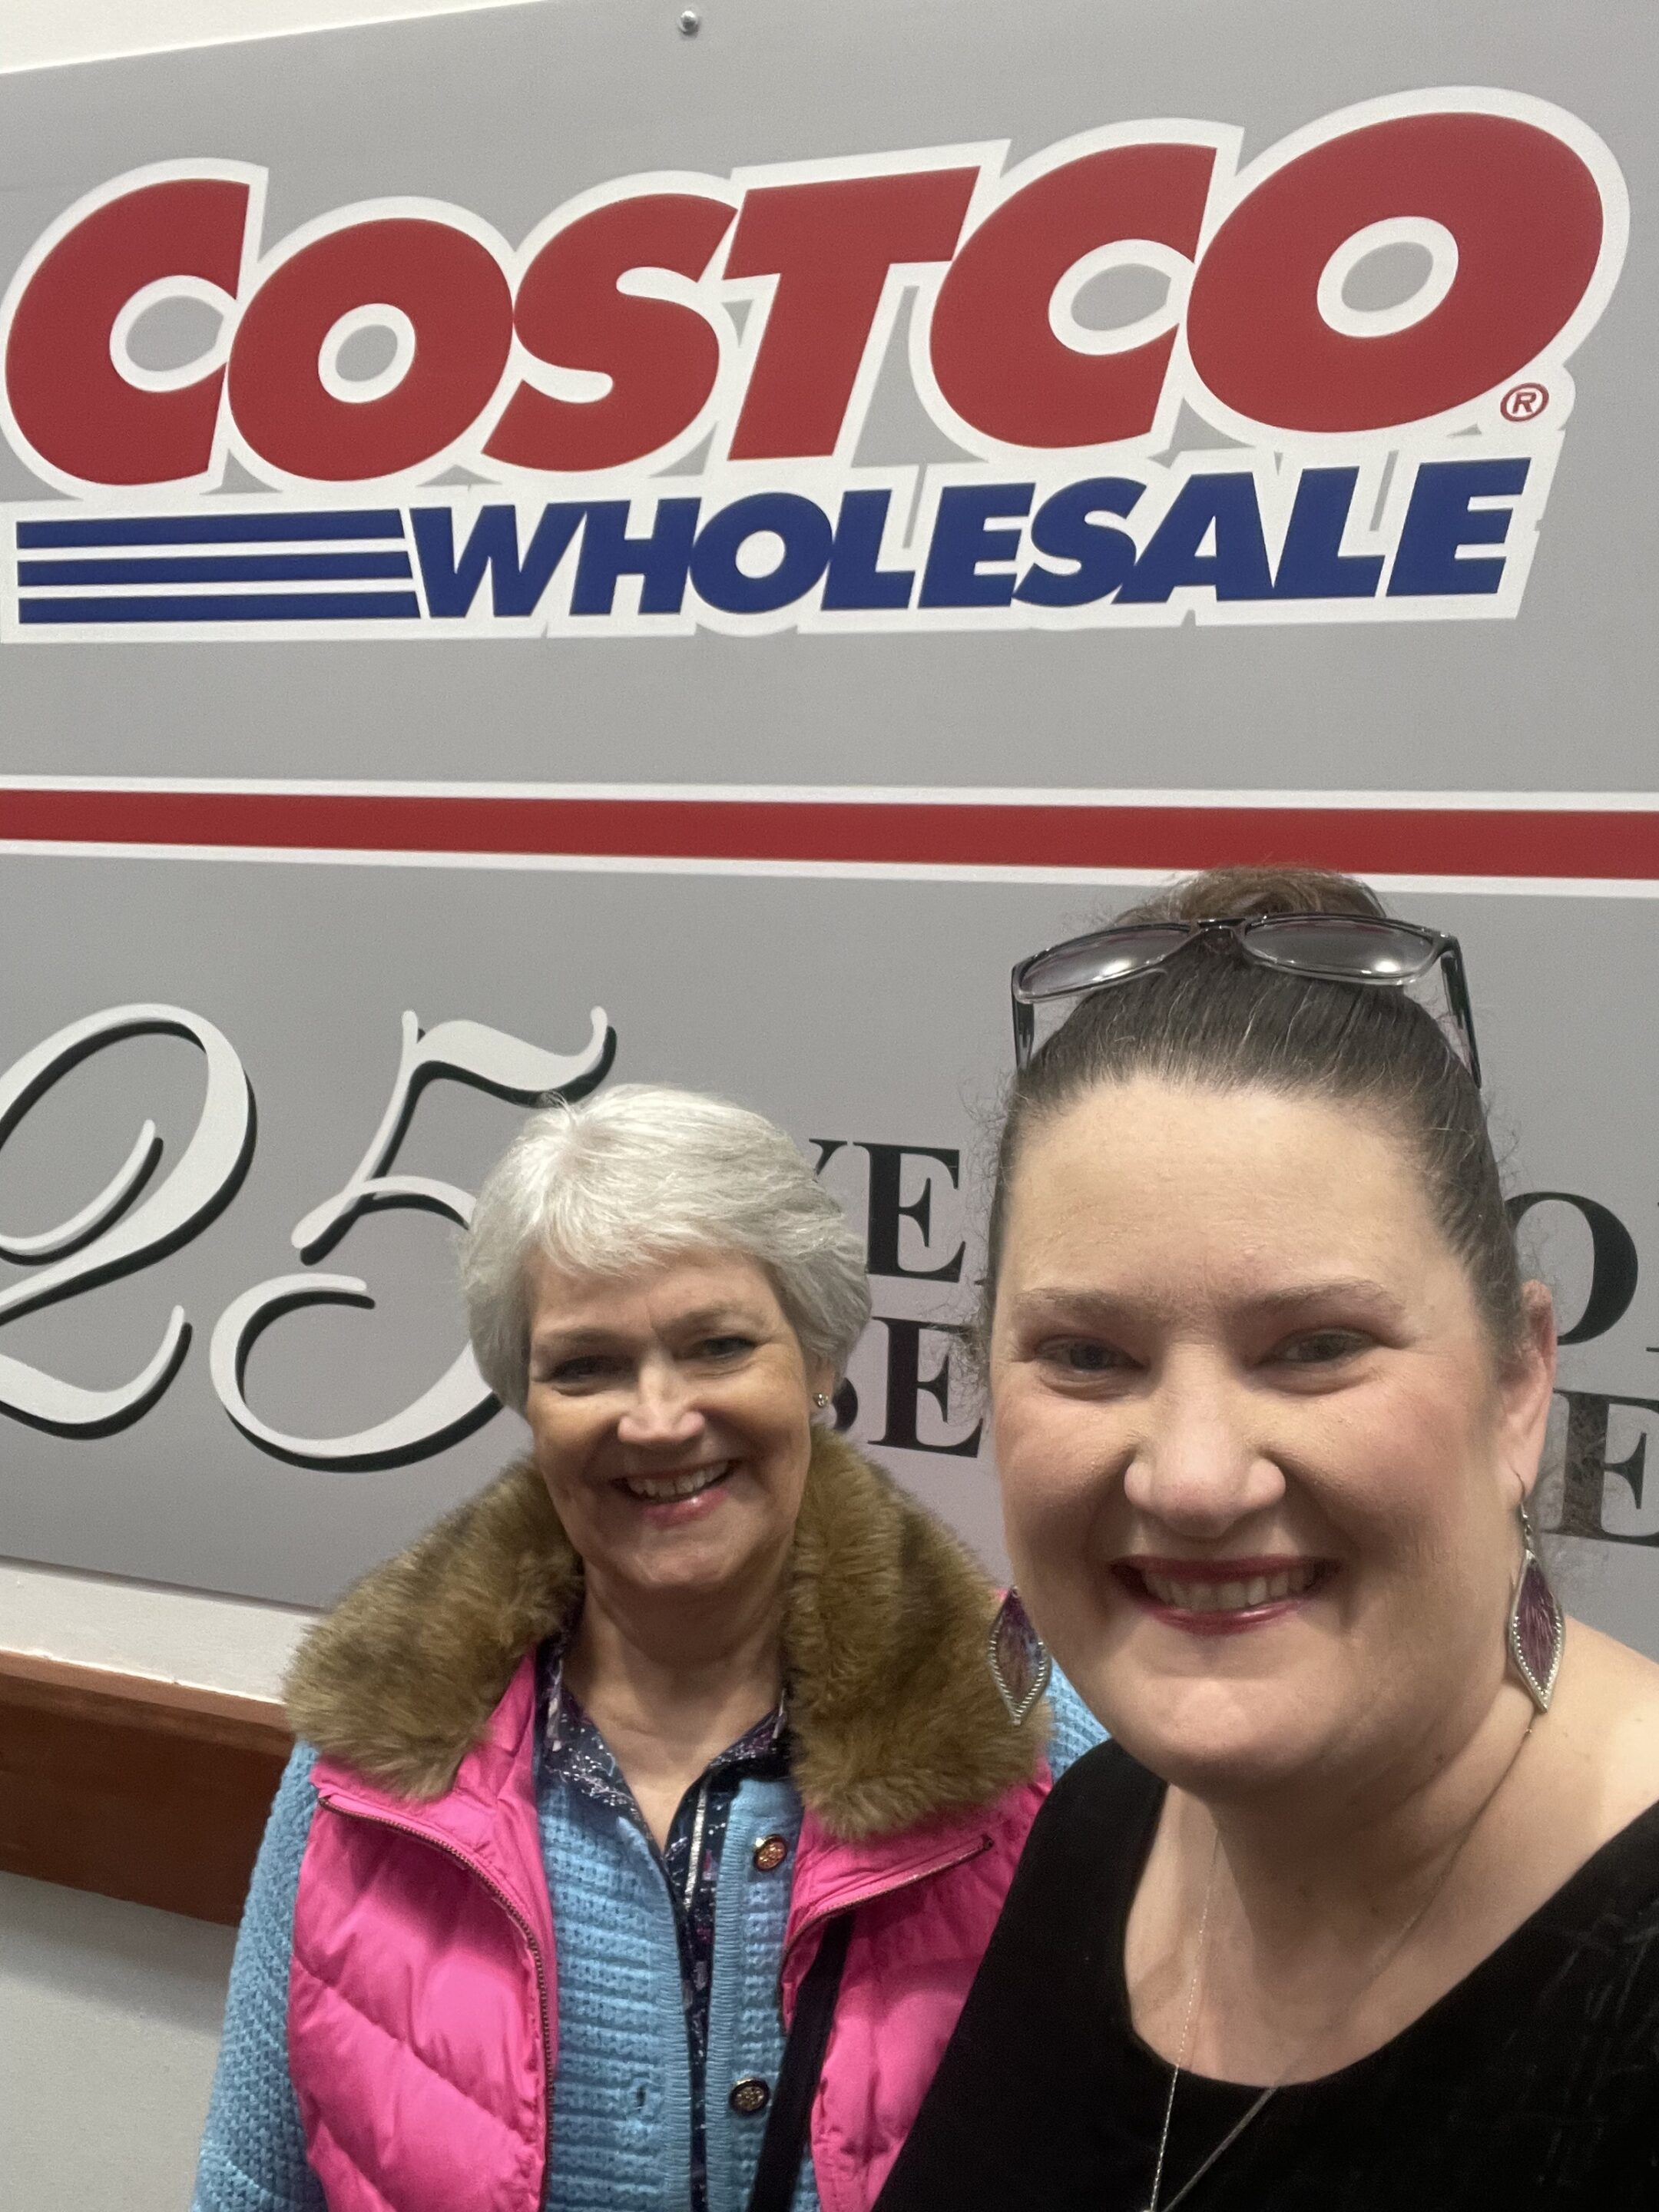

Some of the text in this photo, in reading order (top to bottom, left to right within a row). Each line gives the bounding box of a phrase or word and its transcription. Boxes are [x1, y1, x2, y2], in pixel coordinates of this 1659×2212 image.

[5, 112, 1604, 486] COSTCO
[409, 457, 1532, 619] WHOLESALE
[0, 1002, 617, 1473] 25
